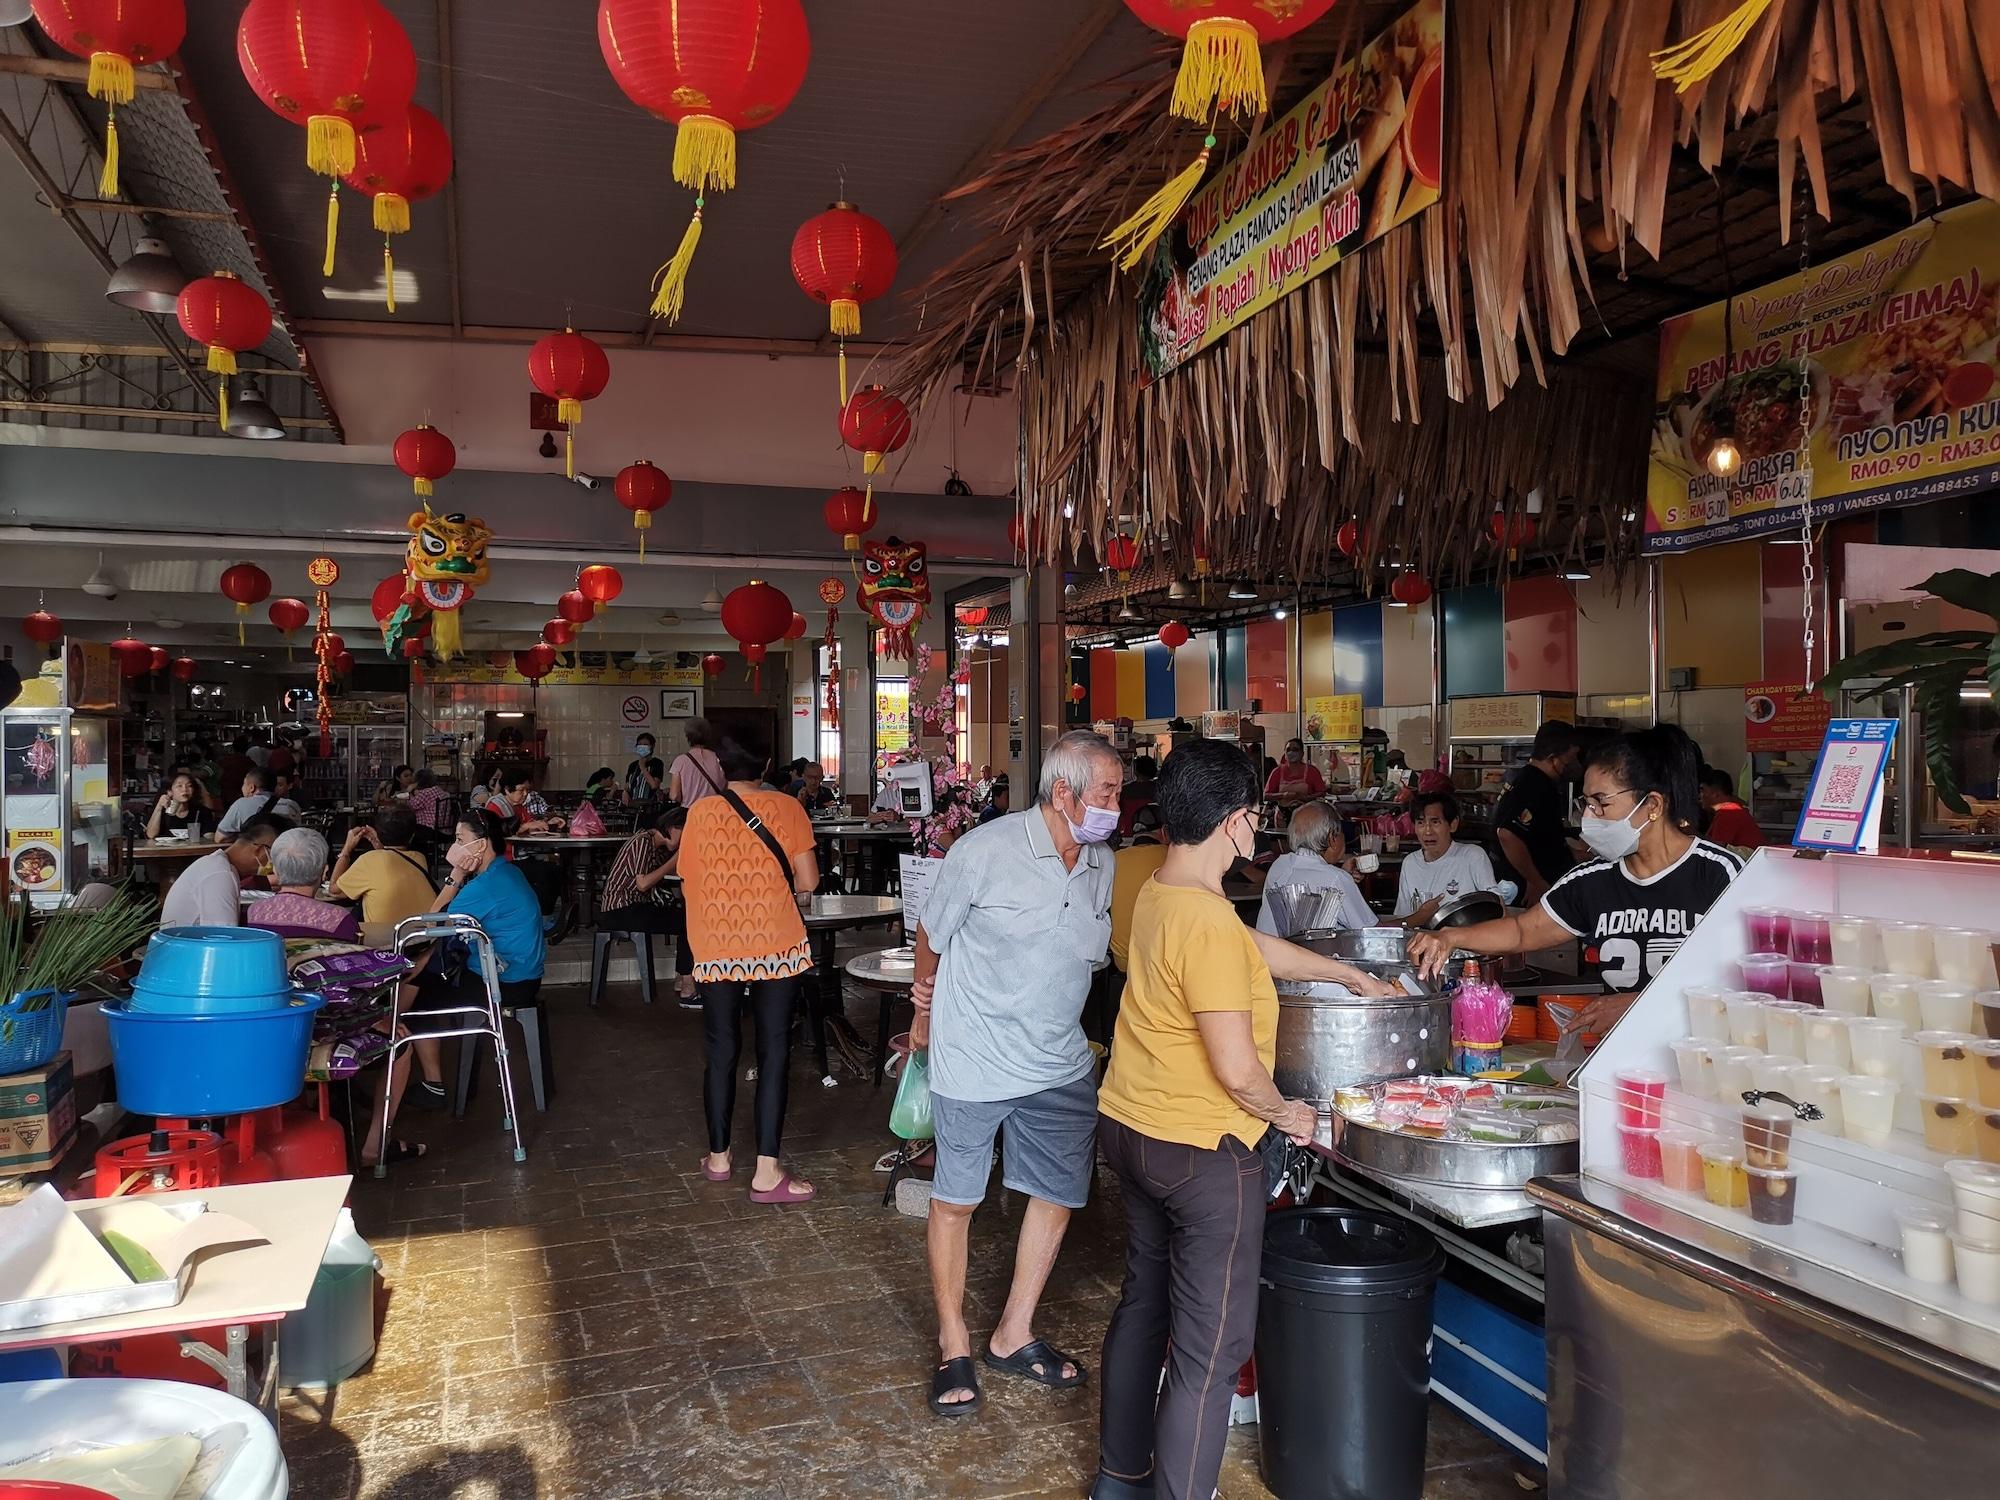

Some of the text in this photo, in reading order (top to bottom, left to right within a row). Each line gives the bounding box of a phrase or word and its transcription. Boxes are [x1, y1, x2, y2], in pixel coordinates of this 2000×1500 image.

[1188, 251, 1218, 292] PENANG
[1219, 228, 1246, 267] PLAZA
[1247, 195, 1287, 251] FAMOUS
[1323, 140, 1360, 195] LAKSA
[1177, 304, 1206, 348] Laksa
[1216, 264, 1256, 322] Popiah
[1268, 225, 1320, 290] Nyonya
[1322, 187, 1361, 250] Kuih
[1684, 266, 1982, 394] PENANG PLAZA (FIMA)
[1737, 450, 1797, 488] LAKSA
[1850, 451, 1922, 482] RM0.90
[1651, 536, 1671, 547] FOR
[1744, 516, 1767, 530] TONY
[1844, 492, 1892, 510] VANESSA
[1894, 474, 1980, 500] 012-4488455
[1666, 506, 1679, 524] S
[1732, 489, 1743, 508] B
[1746, 685, 1804, 695] CHAR KOAY TEOW
